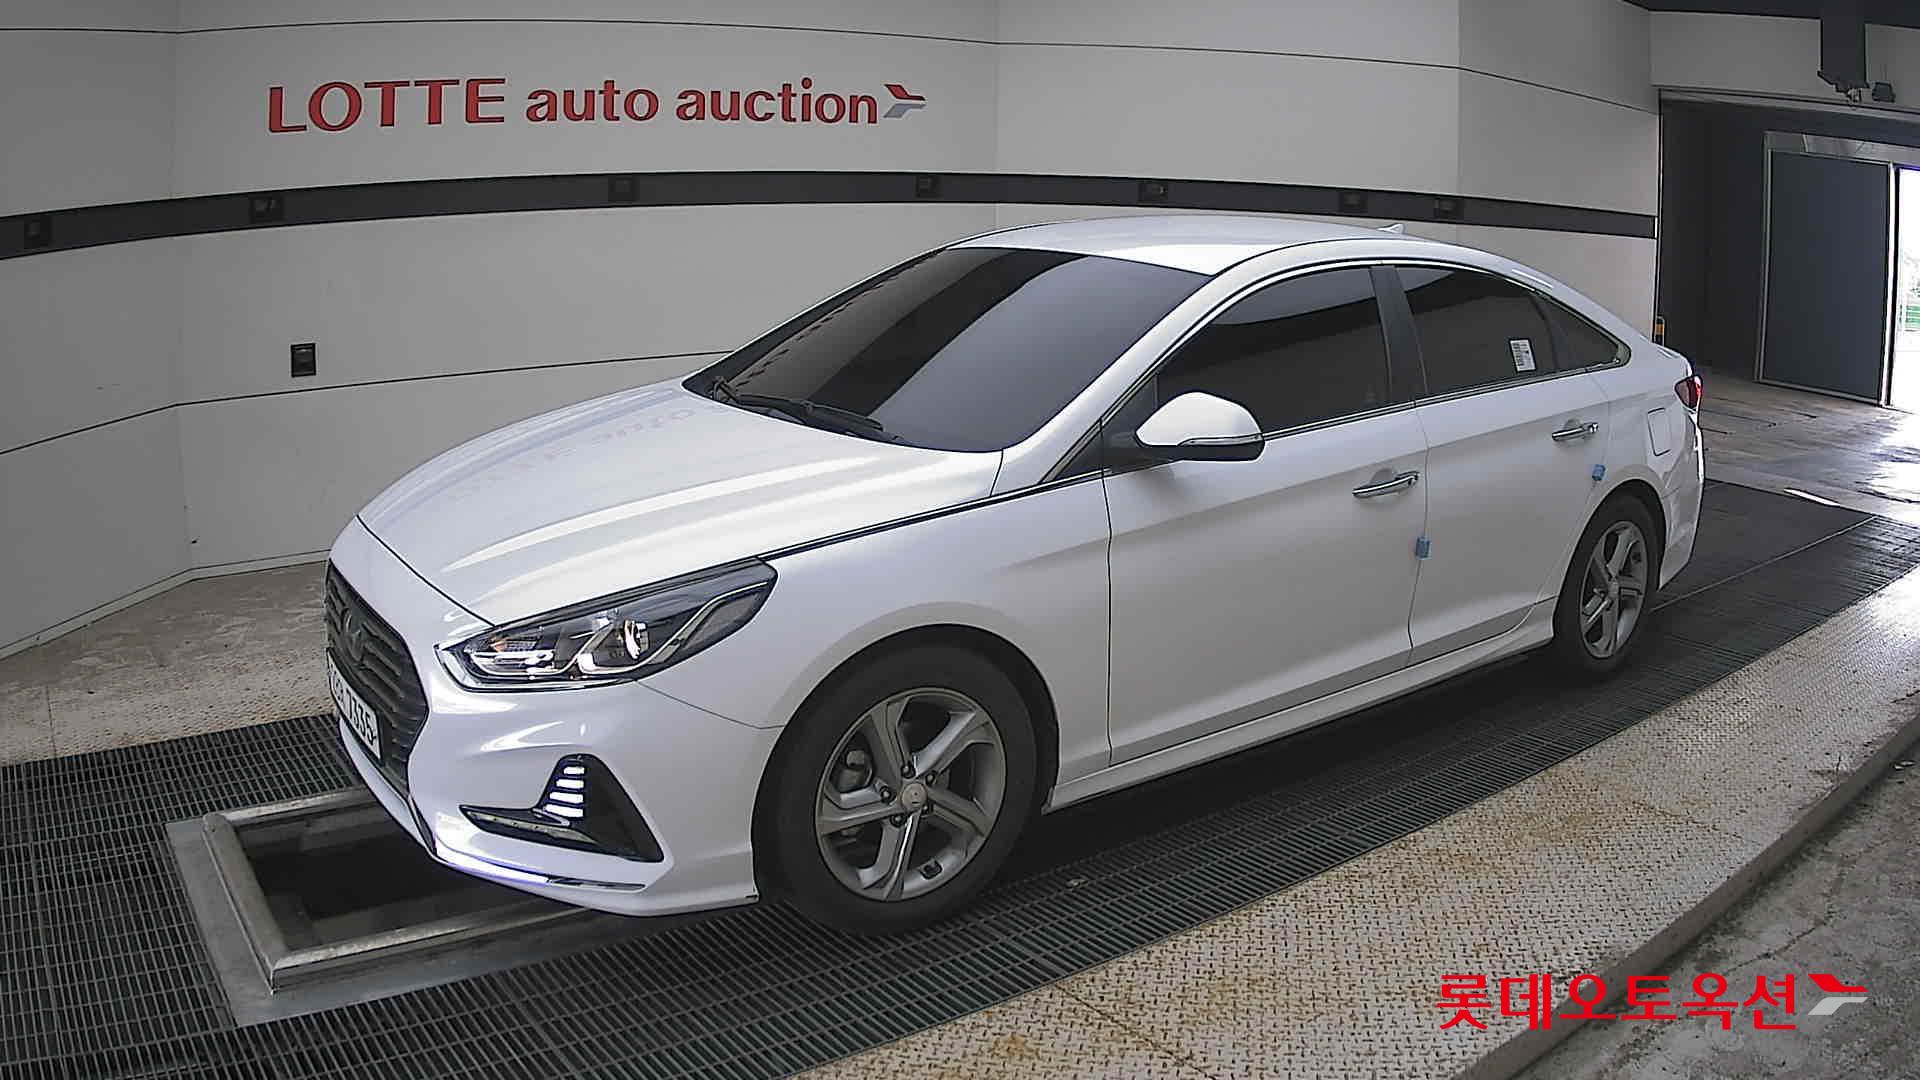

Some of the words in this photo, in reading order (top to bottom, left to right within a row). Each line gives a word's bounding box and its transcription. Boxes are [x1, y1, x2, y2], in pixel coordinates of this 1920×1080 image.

[269, 78, 506, 133] LOTTE
[525, 79, 660, 122] auto
[675, 77, 878, 124] auction
